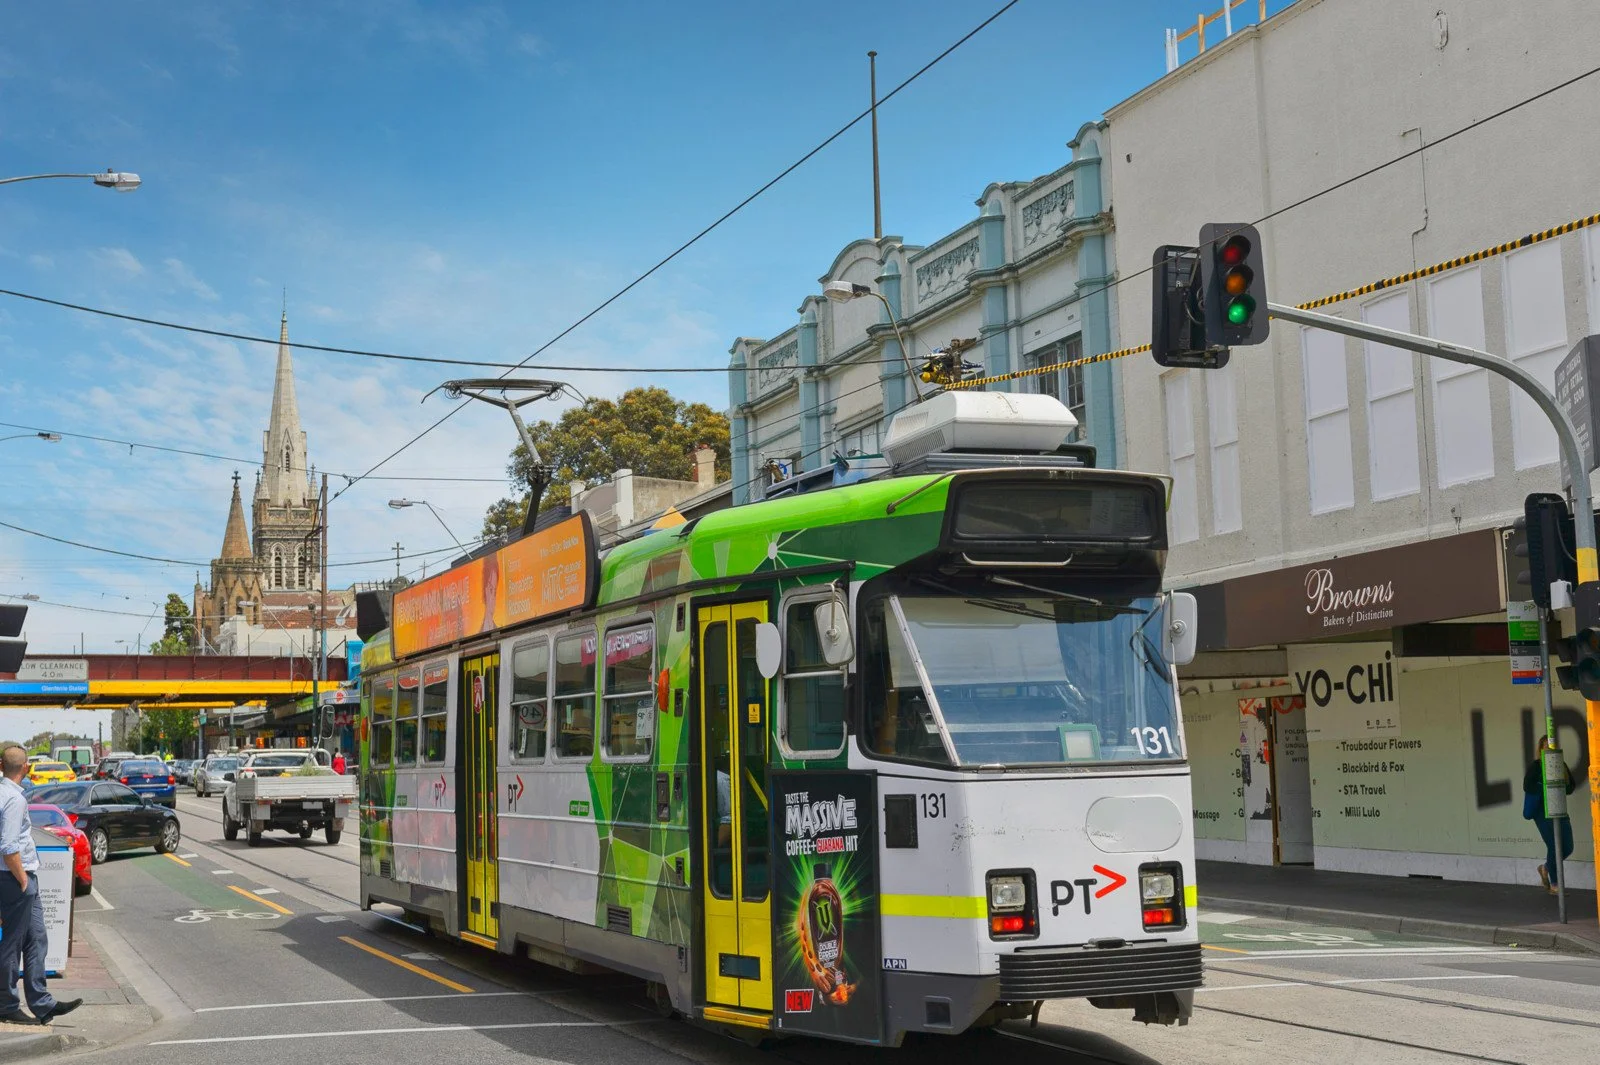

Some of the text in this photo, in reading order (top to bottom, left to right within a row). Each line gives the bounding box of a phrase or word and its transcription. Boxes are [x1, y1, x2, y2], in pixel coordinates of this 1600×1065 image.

[1304, 568, 1394, 614] Browns
[1323, 608, 1394, 627] Bakers of Distinction
[40, 662, 84, 670] CLEARANCE
[1130, 726, 1174, 755] 131
[1341, 739, 1422, 752] Troubadour Flowers
[1342, 761, 1405, 773] Blackbird & Fox
[1343, 784, 1386, 795] STA Travel
[785, 791, 809, 804] TASTE THE
[920, 792, 947, 819] 131
[1344, 806, 1380, 817] Milli Lulo
[785, 794, 858, 838] MASSIVE
[845, 835, 858, 851] HIT
[885, 958, 906, 969] APN
[786, 990, 813, 1012] NEW
